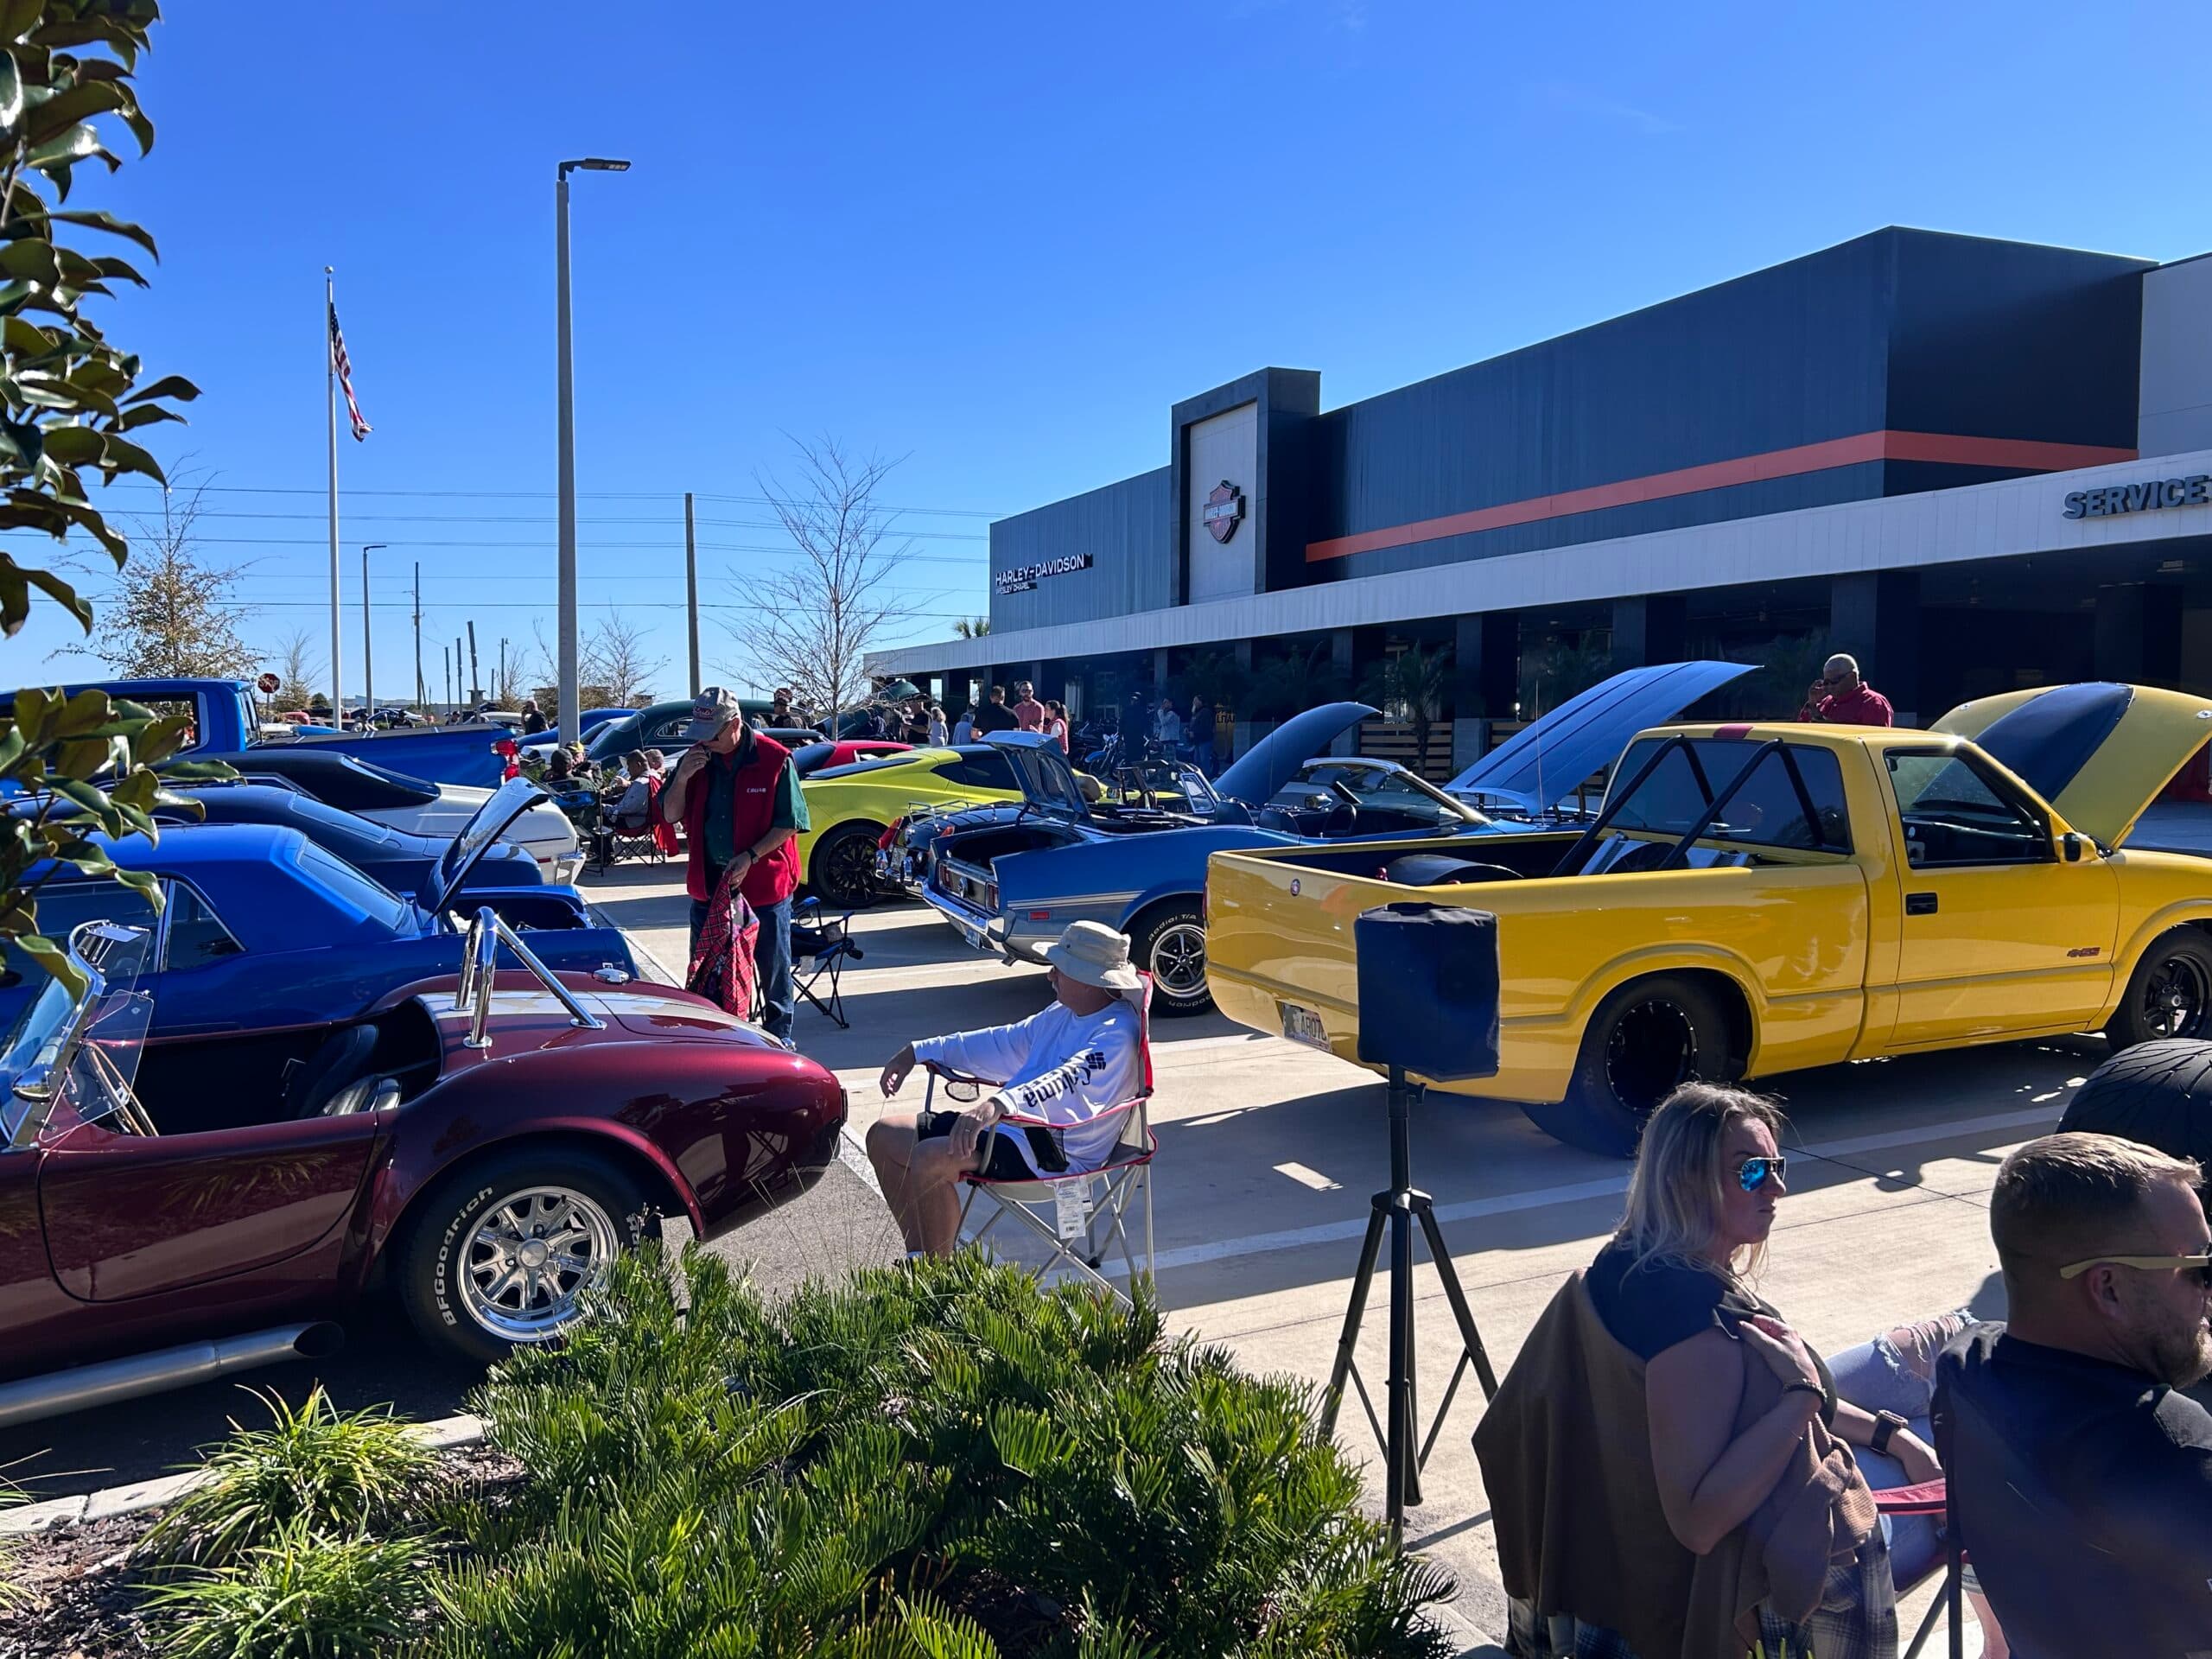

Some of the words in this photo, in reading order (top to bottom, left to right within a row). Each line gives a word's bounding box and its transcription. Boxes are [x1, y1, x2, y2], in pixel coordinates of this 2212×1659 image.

[2063, 474, 2208, 519] SERVICE
[995, 553, 1085, 587] HARLEY-DAVIDSON
[1147, 915, 1179, 942] Radial
[1168, 994, 1212, 1008] oodrich
[434, 1186, 493, 1326] BFGoodrich
